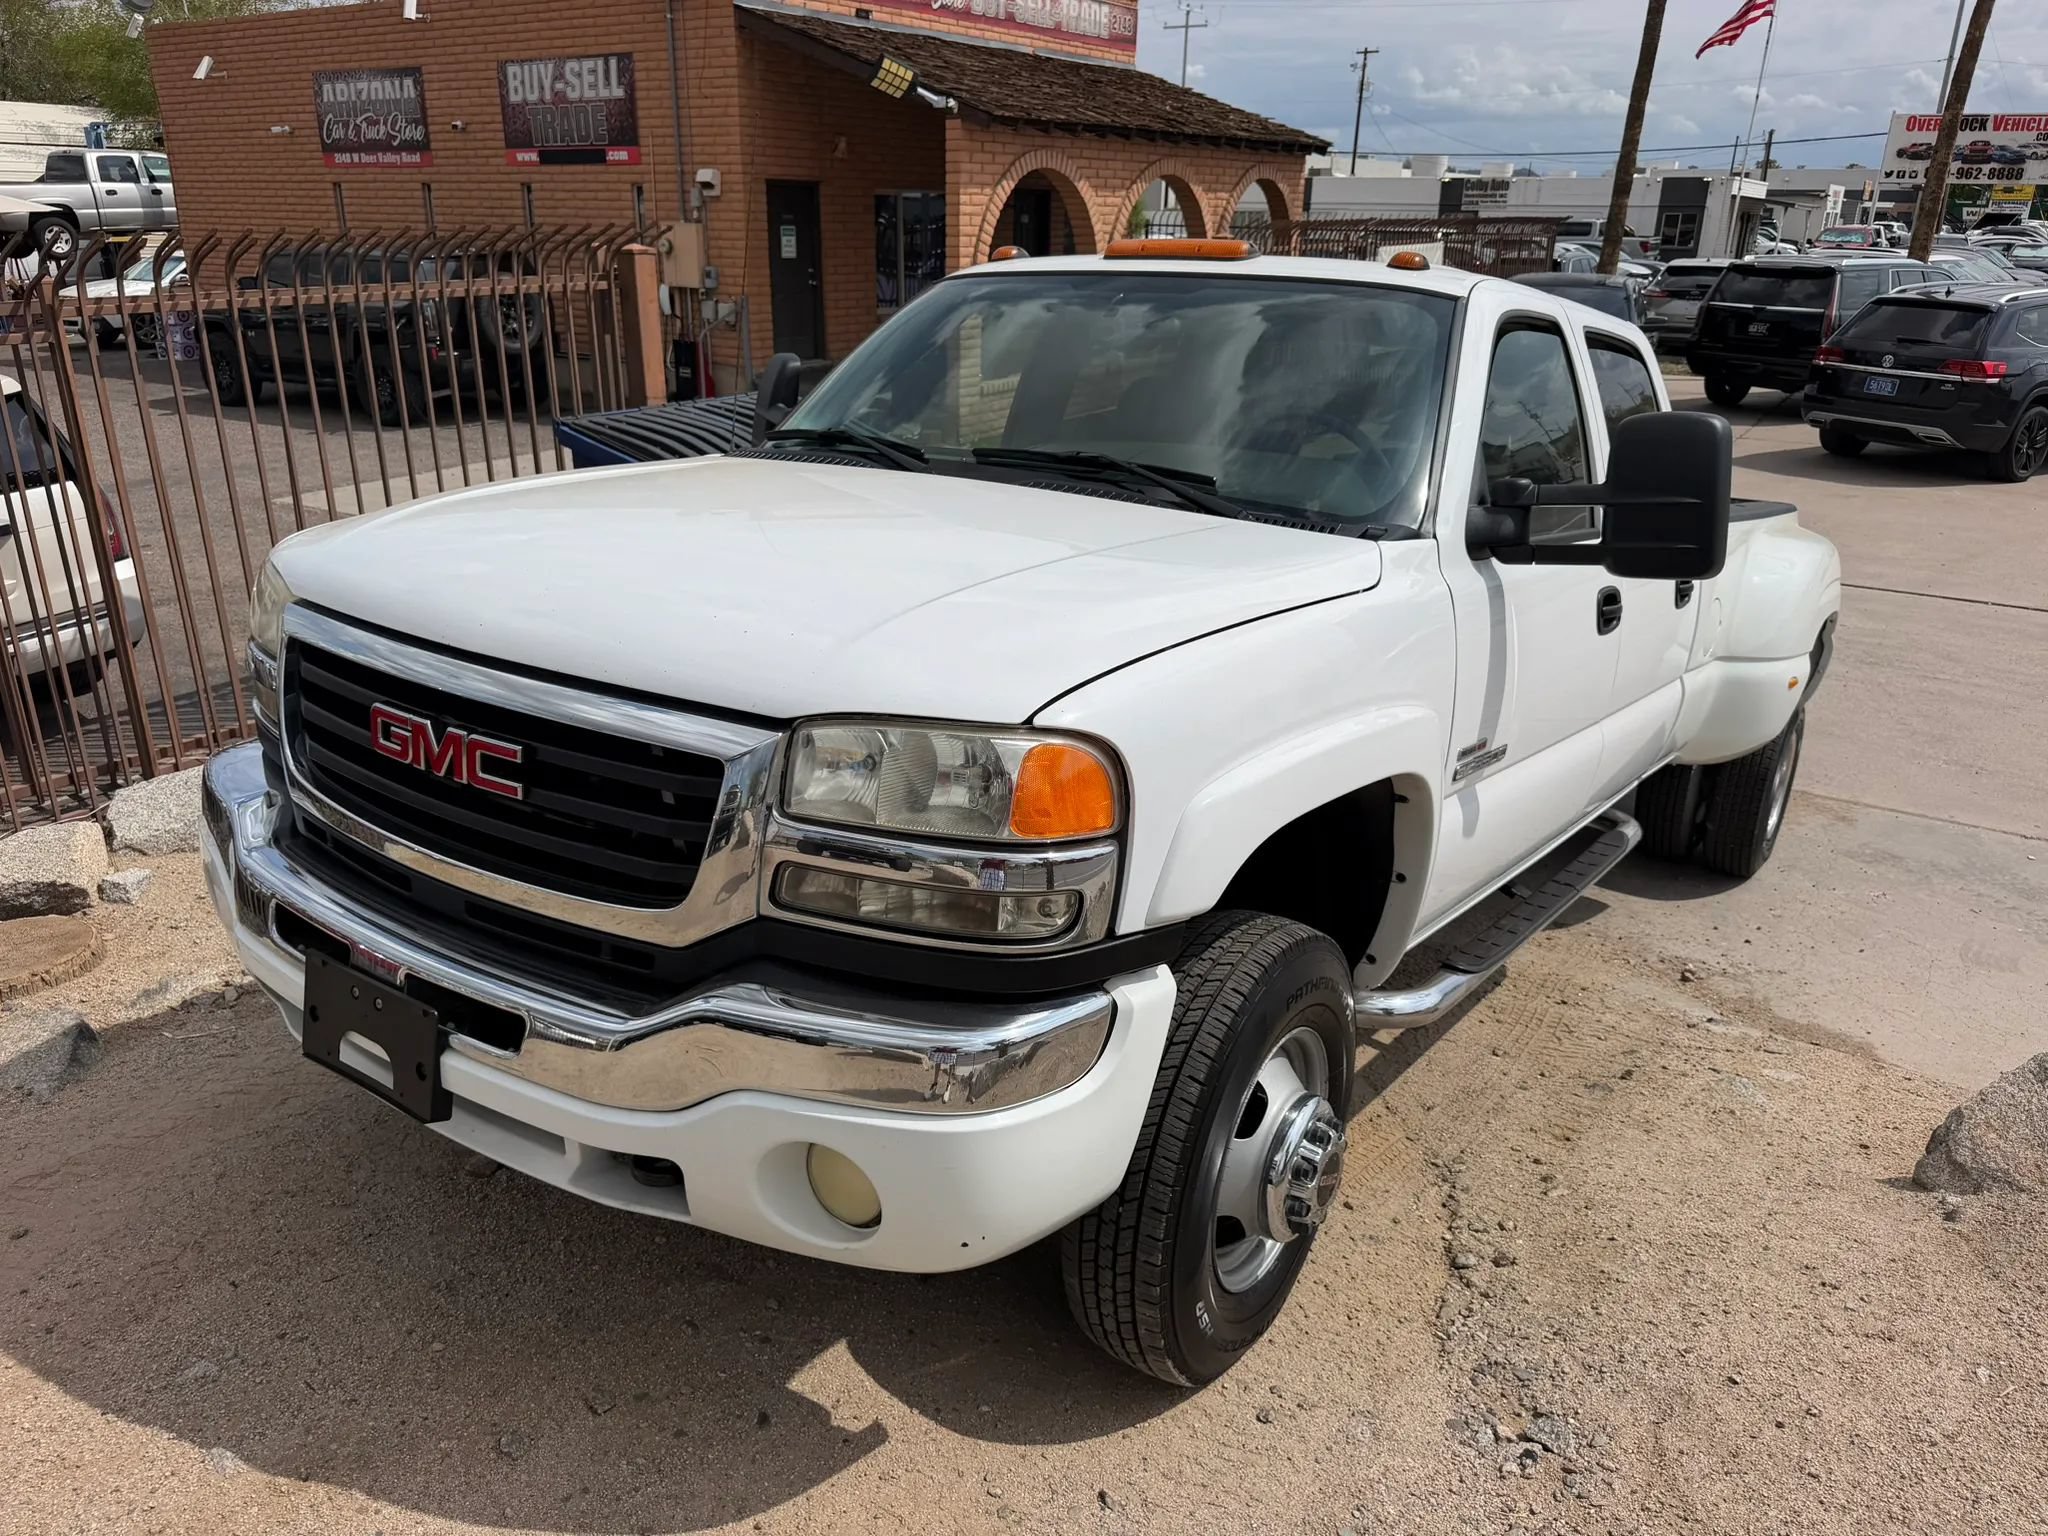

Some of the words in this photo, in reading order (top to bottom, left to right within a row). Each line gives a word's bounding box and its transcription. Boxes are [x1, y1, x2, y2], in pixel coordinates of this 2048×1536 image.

[505, 56, 625, 104] BUY-SELL
[321, 78, 421, 120] ARIZONA
[323, 113, 345, 143] Car
[347, 120, 358, 141] &
[356, 113, 388, 143] Truck
[387, 112, 426, 146] Store
[526, 102, 609, 146] TRADE
[1906, 114, 1989, 132] OVEROCK
[378, 152, 401, 166] Valley
[401, 152, 421, 163] Road
[606, 150, 628, 161] .com
[1924, 167, 2025, 181] -962-8888
[370, 702, 523, 800] GMC
